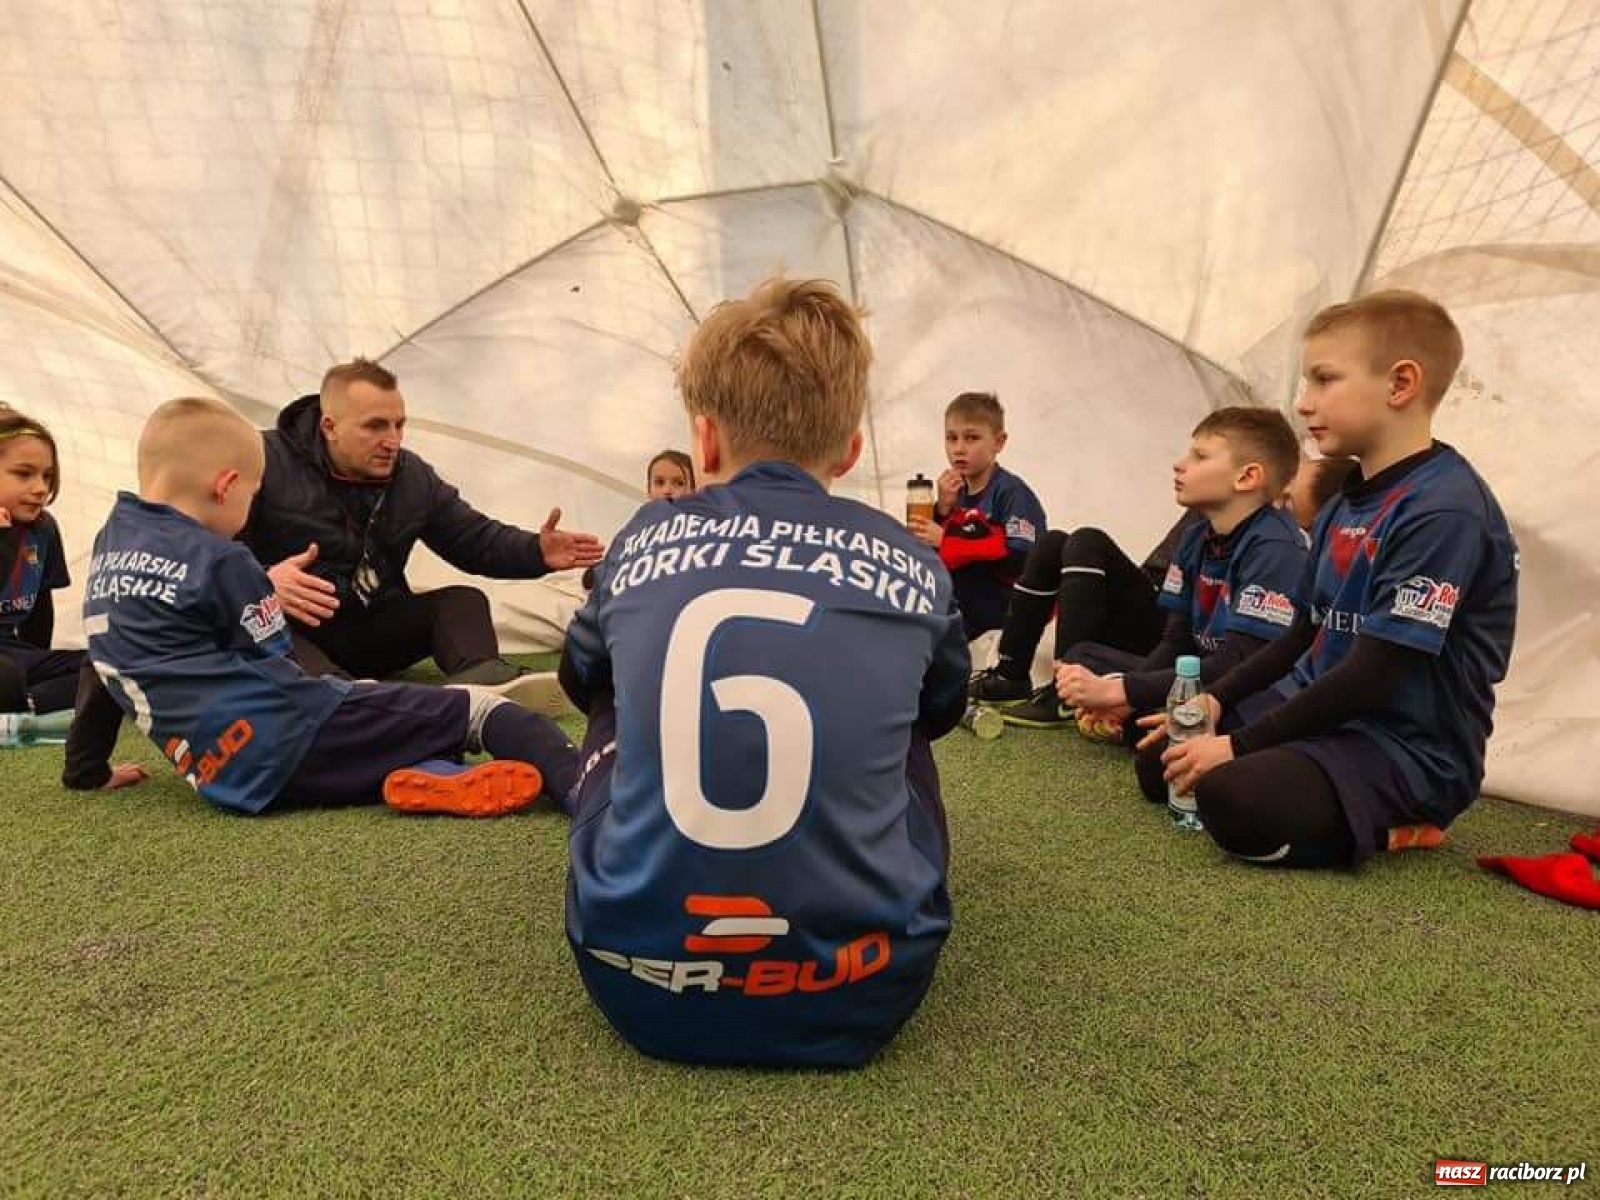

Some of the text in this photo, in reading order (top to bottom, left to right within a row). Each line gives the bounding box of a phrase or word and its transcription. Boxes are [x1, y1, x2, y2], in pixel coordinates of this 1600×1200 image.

[610, 541, 732, 596] GÓRKI
[619, 513, 761, 557] AKADEMIA
[771, 519, 937, 599] PIŁKARSKA
[660, 587, 815, 850] 6
